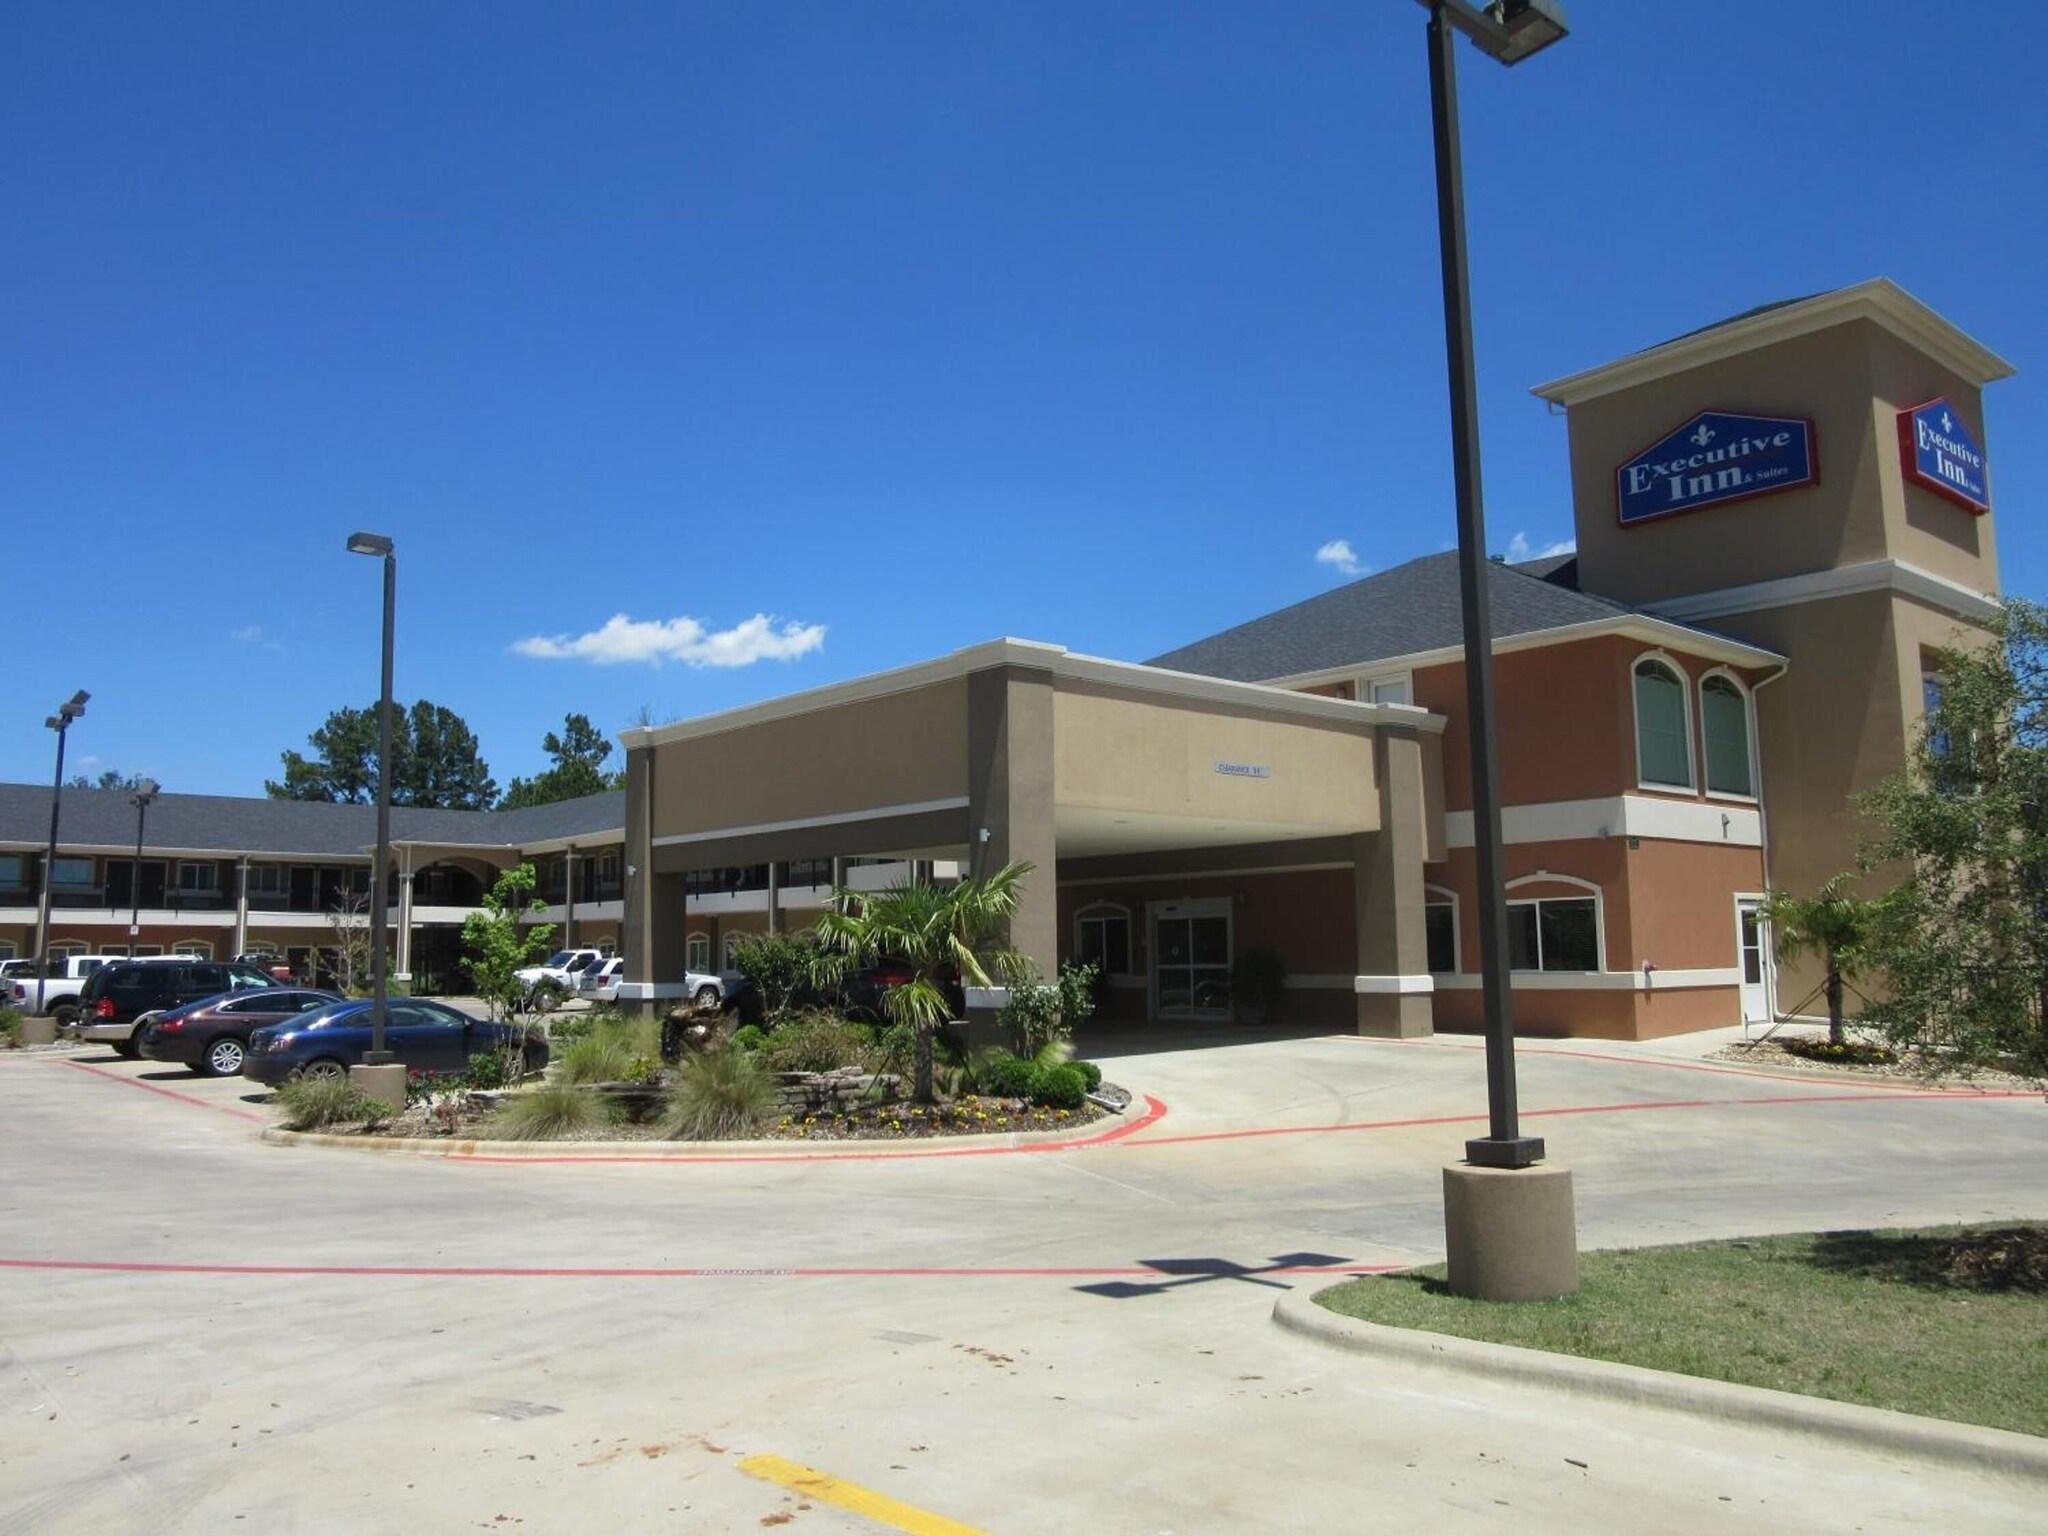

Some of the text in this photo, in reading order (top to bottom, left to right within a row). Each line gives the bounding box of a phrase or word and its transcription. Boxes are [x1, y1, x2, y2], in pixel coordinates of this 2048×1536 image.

[1627, 431, 1791, 495] Executive
[1916, 417, 1980, 468] Executive
[1669, 466, 1744, 501] Inn
[1756, 466, 1789, 481] Suites
[1936, 448, 1965, 488] Inn
